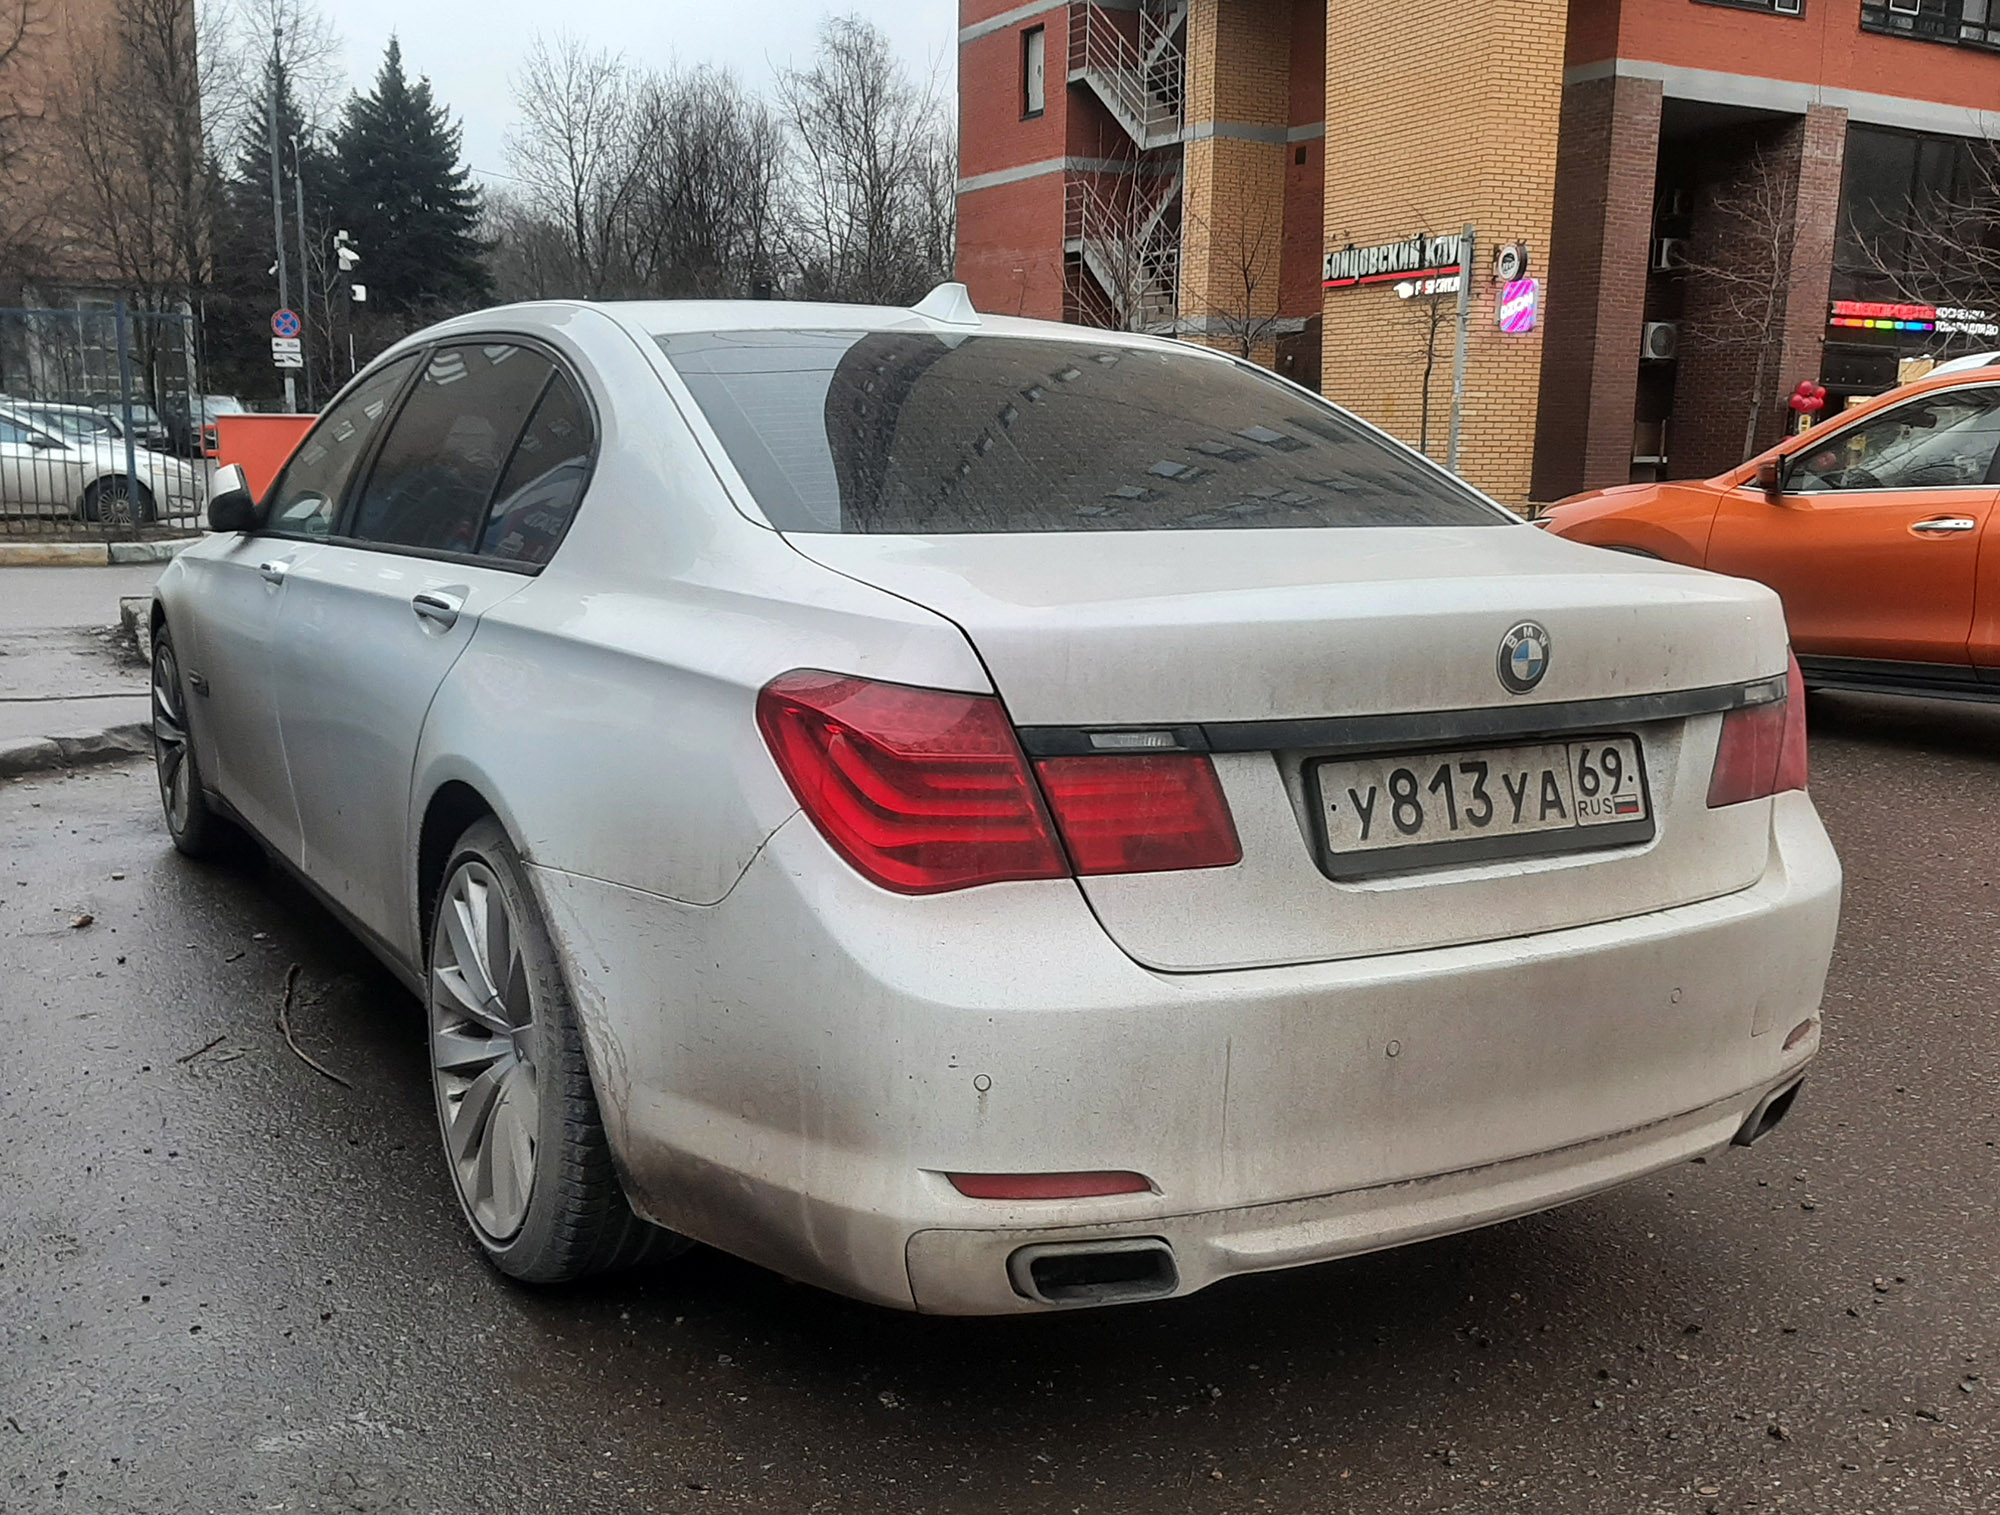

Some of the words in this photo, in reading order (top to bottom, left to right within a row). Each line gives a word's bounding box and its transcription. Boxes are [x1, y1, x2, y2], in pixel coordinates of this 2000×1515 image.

[1323, 233, 1420, 280] БОЙЦОВСКИЙ
[1506, 626, 1548, 648] BMW
[1577, 746, 1623, 798] 69
[1577, 795, 1614, 818] RUS
